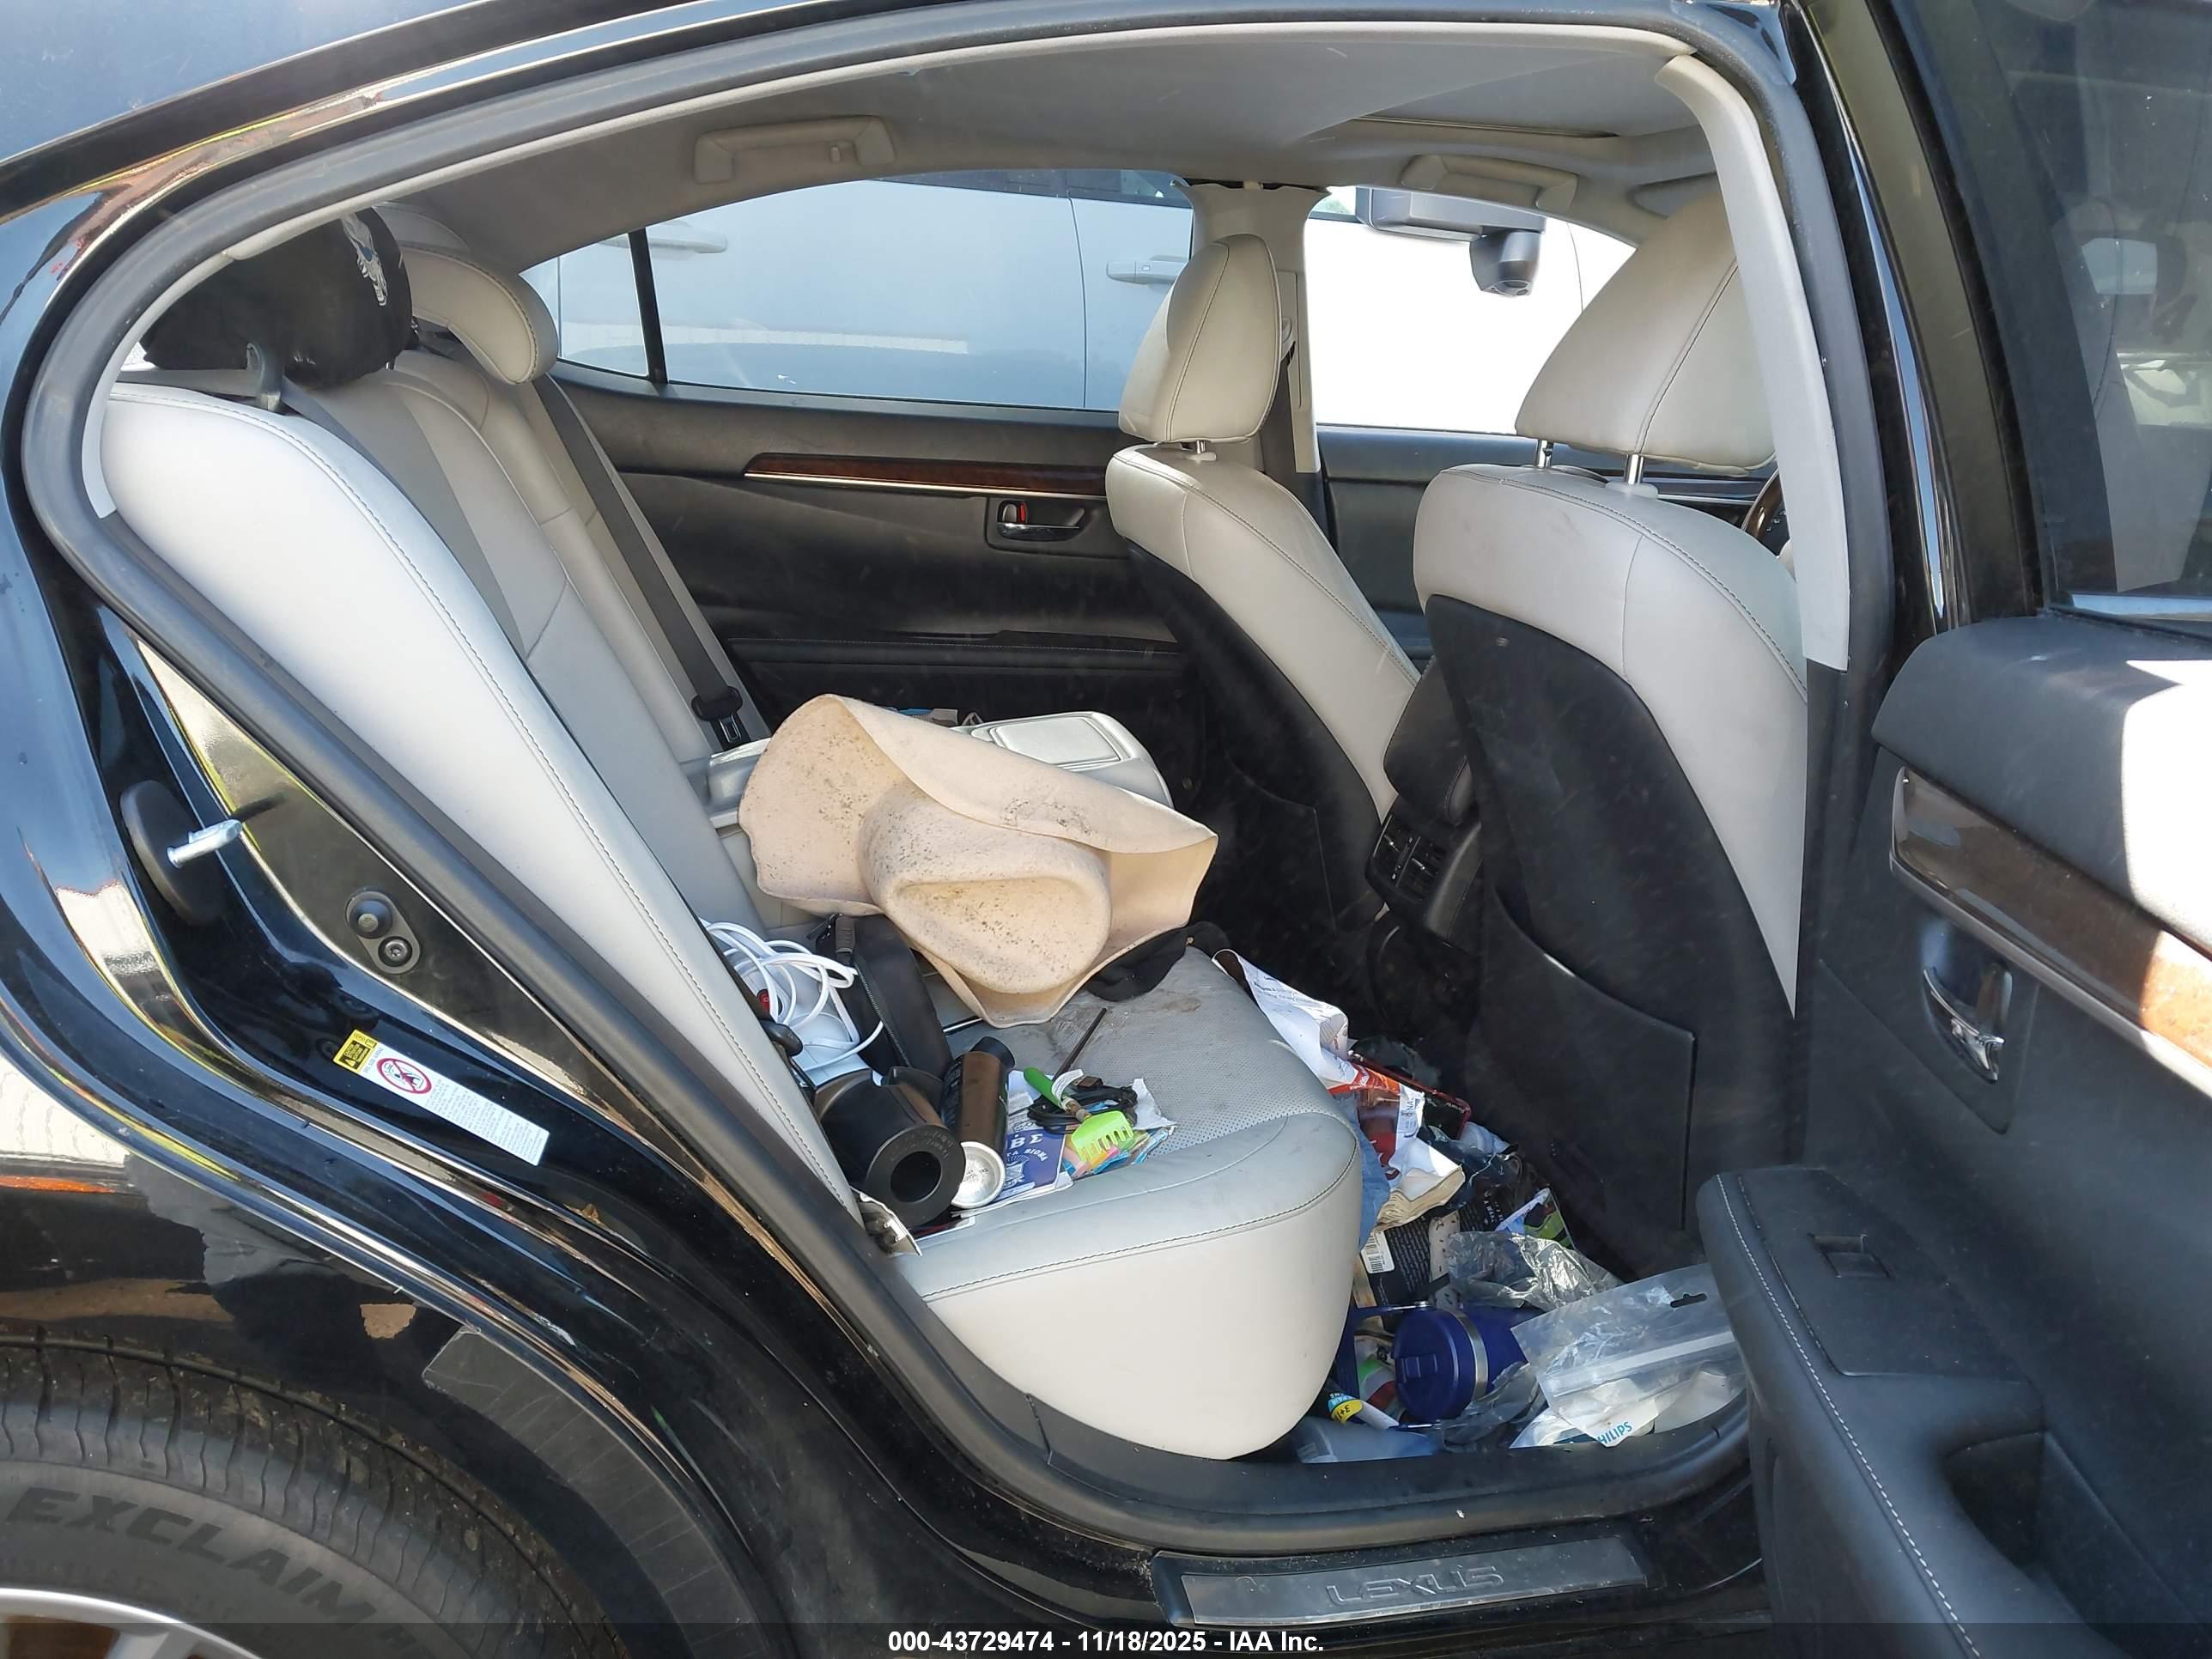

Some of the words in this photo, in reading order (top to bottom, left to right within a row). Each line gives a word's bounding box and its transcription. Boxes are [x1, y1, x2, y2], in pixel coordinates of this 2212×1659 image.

[1597, 1421, 1632, 1443] HILIPS
[5, 1486, 378, 1628] EXCLAIM
[1325, 1565, 1505, 1607] LEXUS
